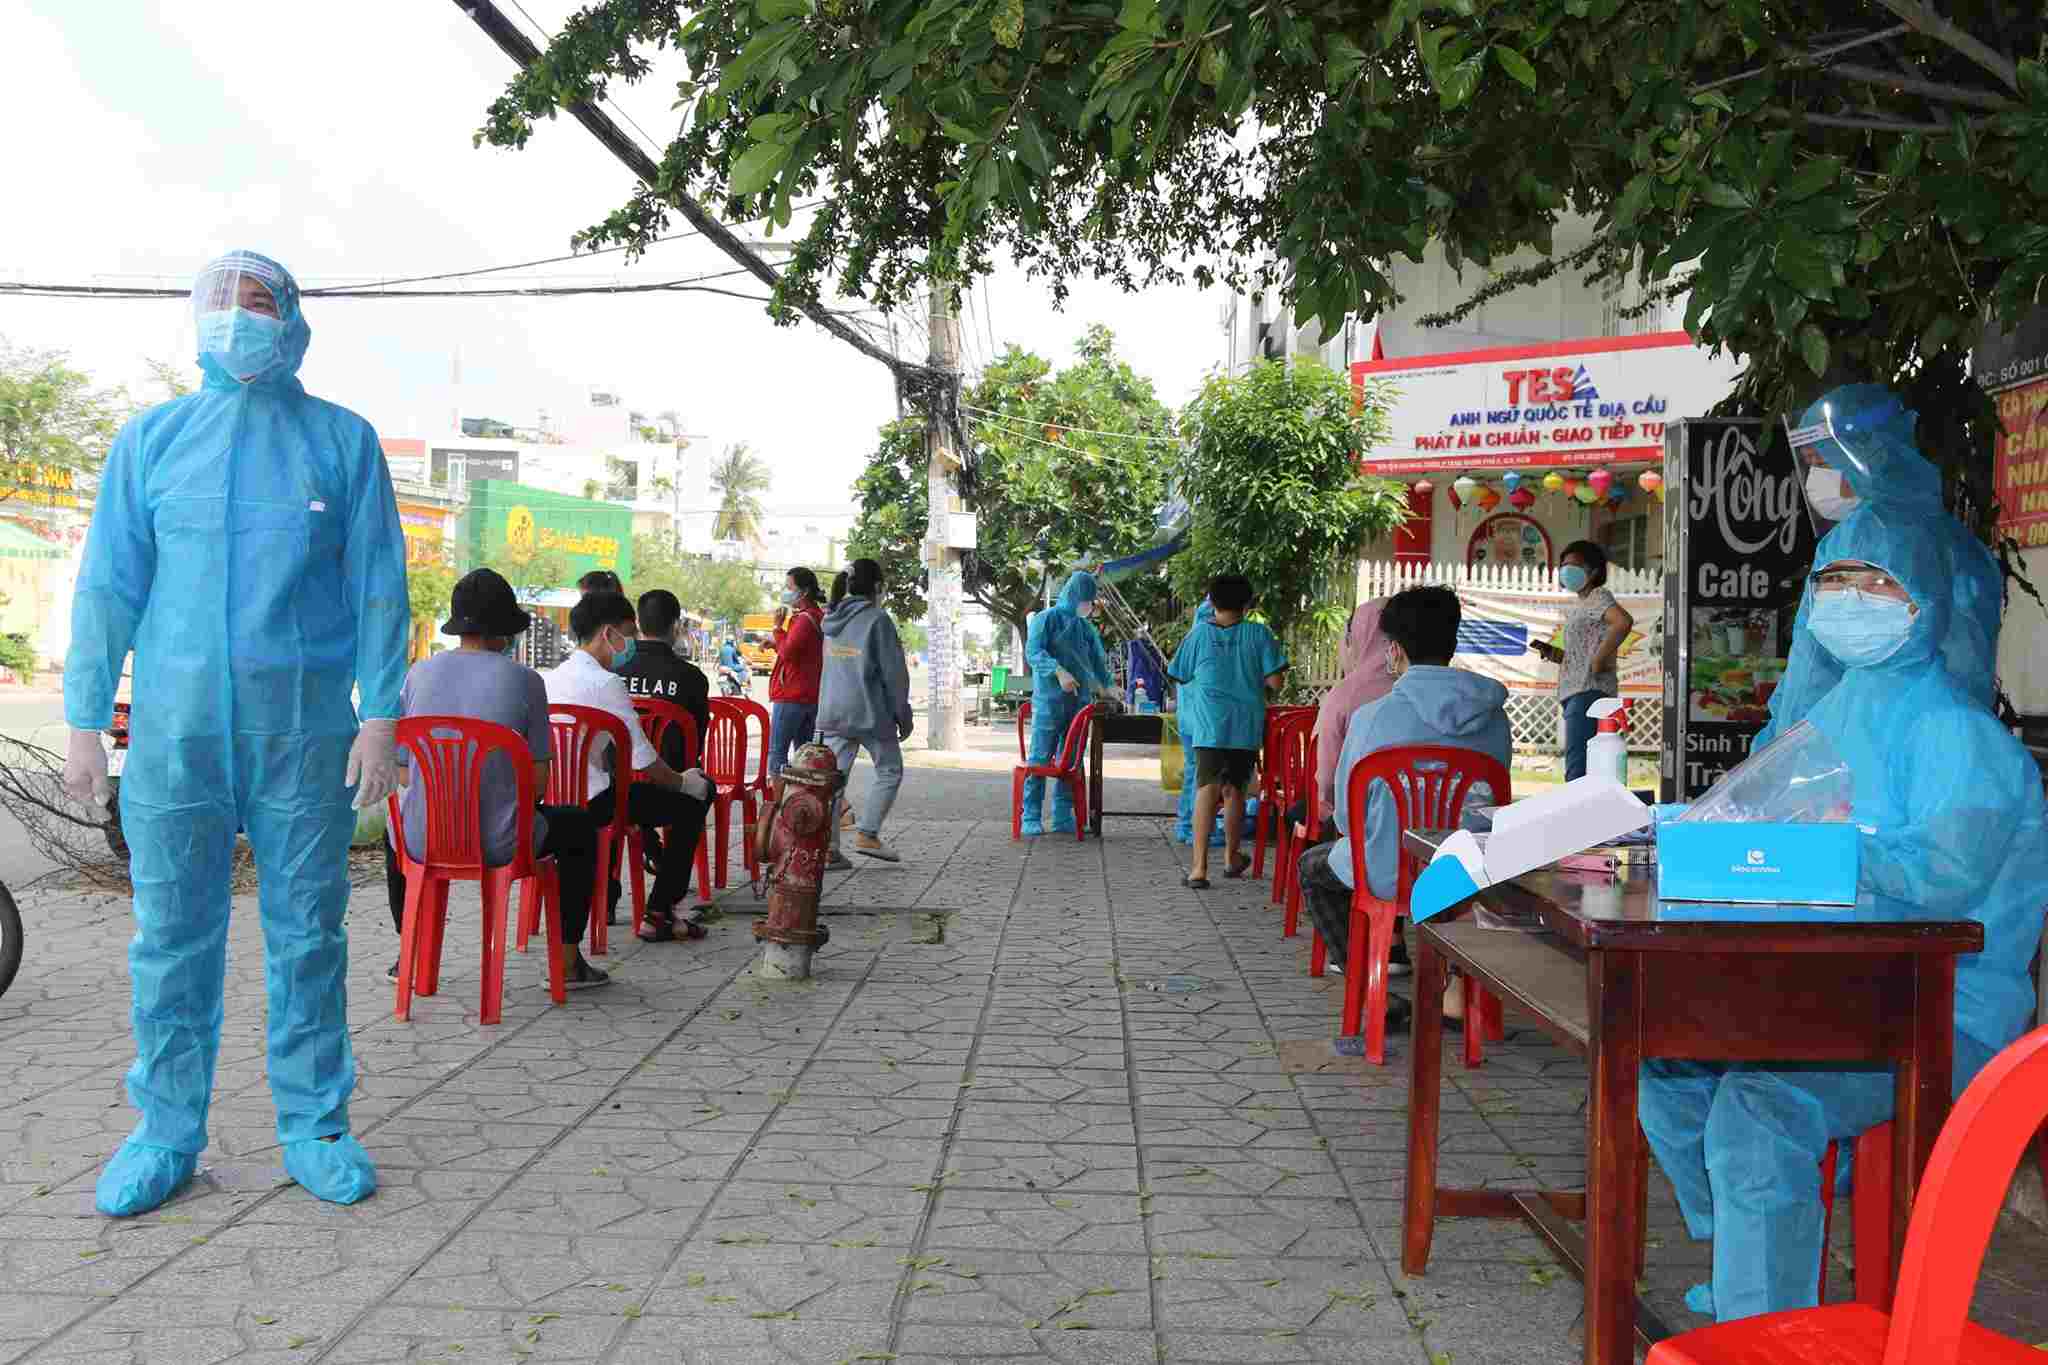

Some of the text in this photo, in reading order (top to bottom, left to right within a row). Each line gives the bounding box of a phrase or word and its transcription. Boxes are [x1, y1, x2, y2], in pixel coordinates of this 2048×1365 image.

[1503, 366, 1574, 408] TES
[1450, 411, 1481, 426] ANH
[1523, 400, 1569, 422] QUỐC
[1415, 430, 1455, 450] PHÁT
[1486, 424, 1540, 447] CHUẨN
[1552, 427, 1593, 443] GIAO
[1600, 416, 1635, 441] TIẾP
[1689, 426, 1801, 554] Hồng
[1698, 562, 1769, 598] Cafe
[1686, 733, 1752, 752] Sinh T
